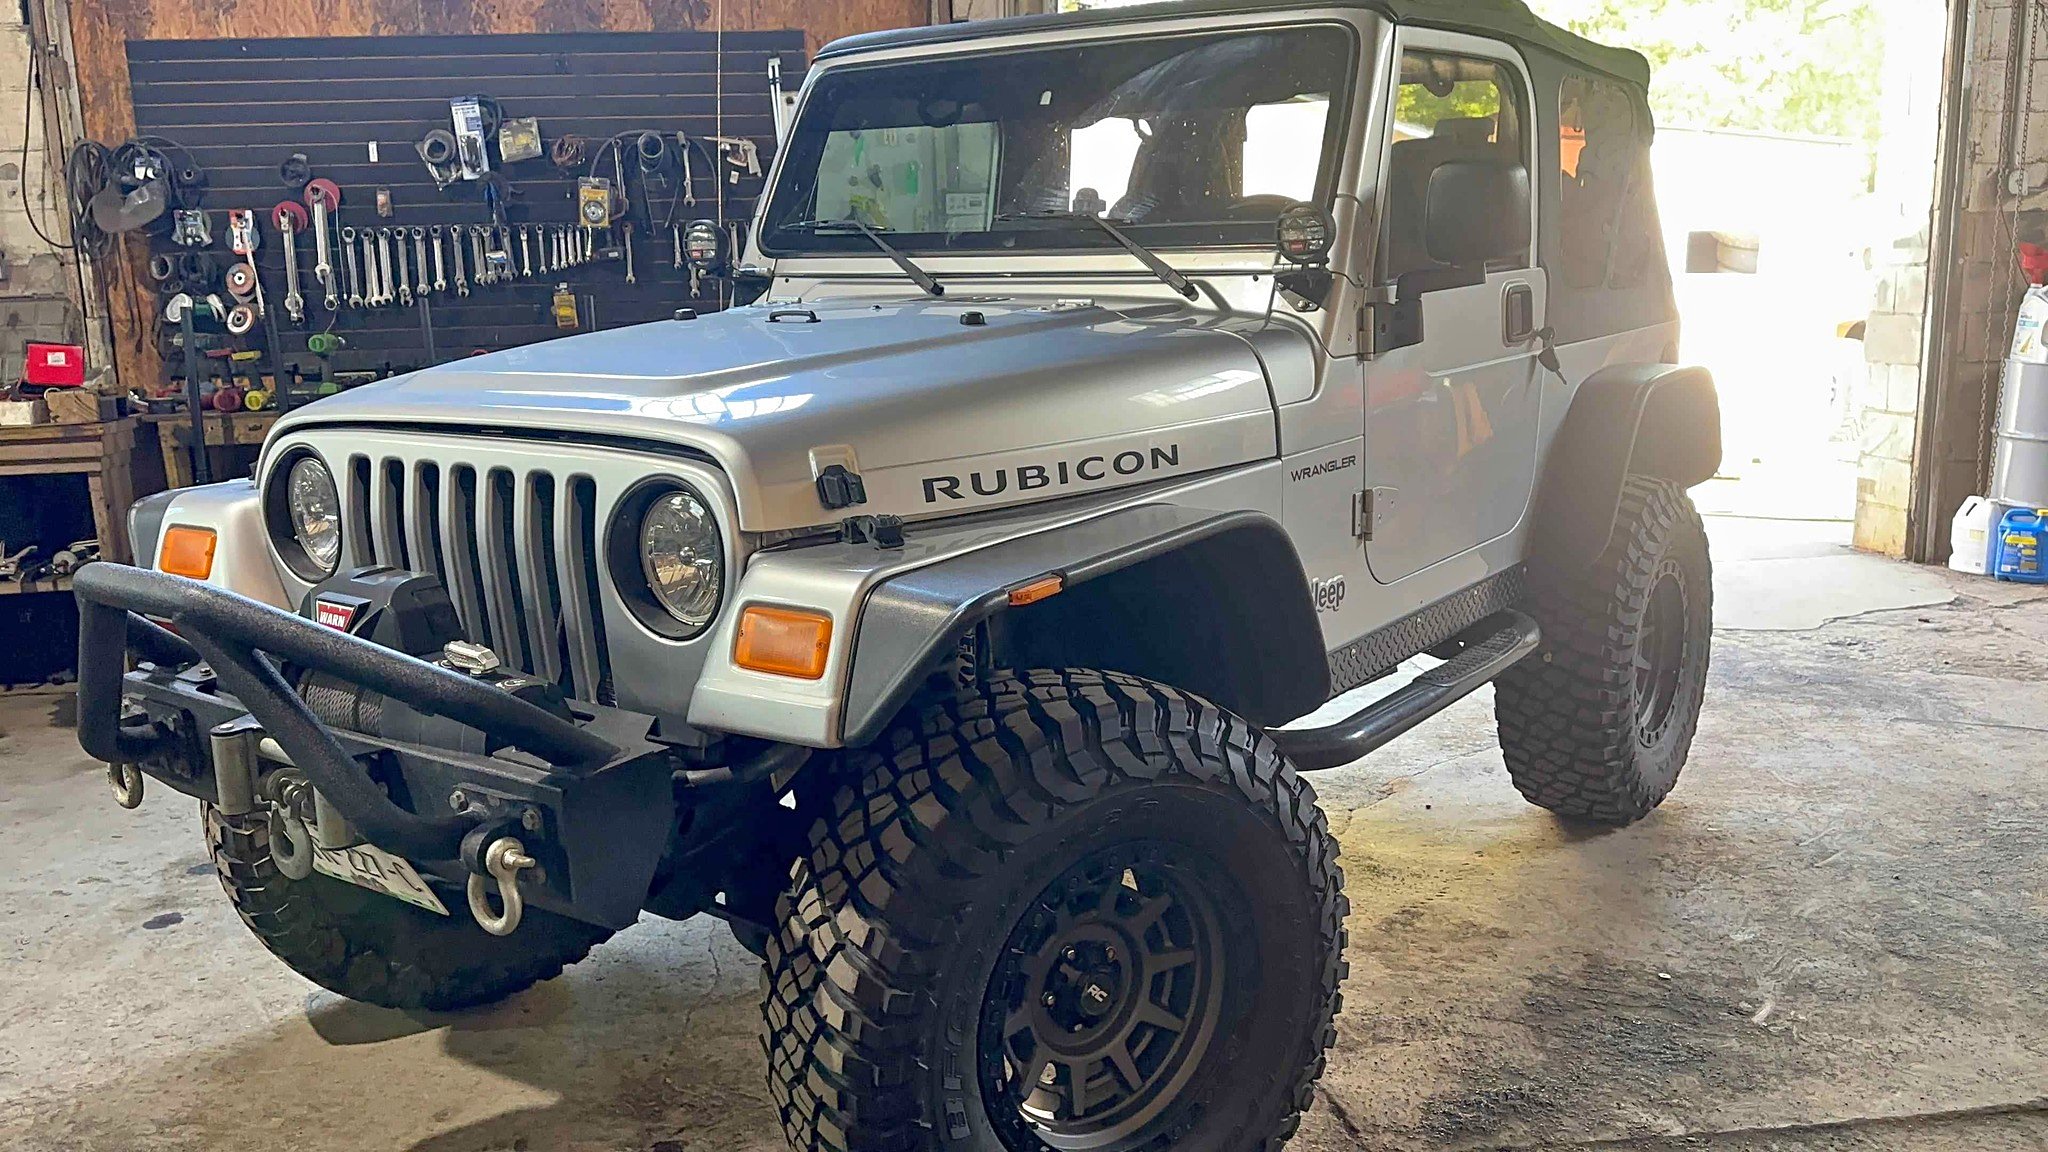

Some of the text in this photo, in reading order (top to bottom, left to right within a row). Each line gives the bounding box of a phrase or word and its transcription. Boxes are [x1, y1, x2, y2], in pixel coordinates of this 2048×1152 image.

[922, 444, 1179, 503] RUBICON
[1290, 455, 1356, 482] WRANGLER
[320, 611, 346, 628] WARN
[1087, 984, 1108, 1003] RC
